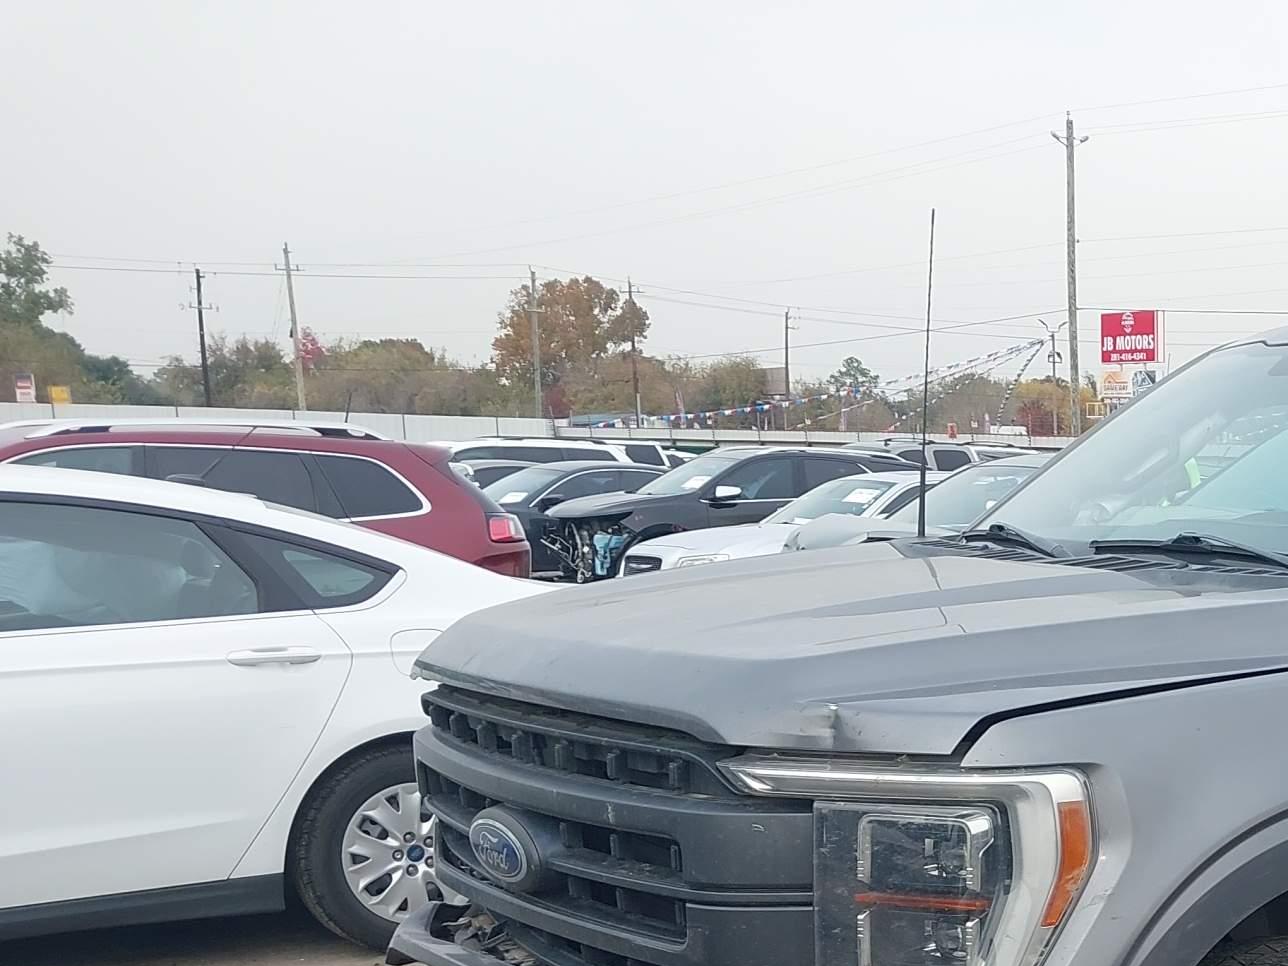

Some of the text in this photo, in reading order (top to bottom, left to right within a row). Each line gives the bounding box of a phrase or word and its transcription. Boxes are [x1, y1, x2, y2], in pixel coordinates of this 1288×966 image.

[1103, 334, 1154, 351] JB MOTORS
[478, 831, 510, 870] Ford
